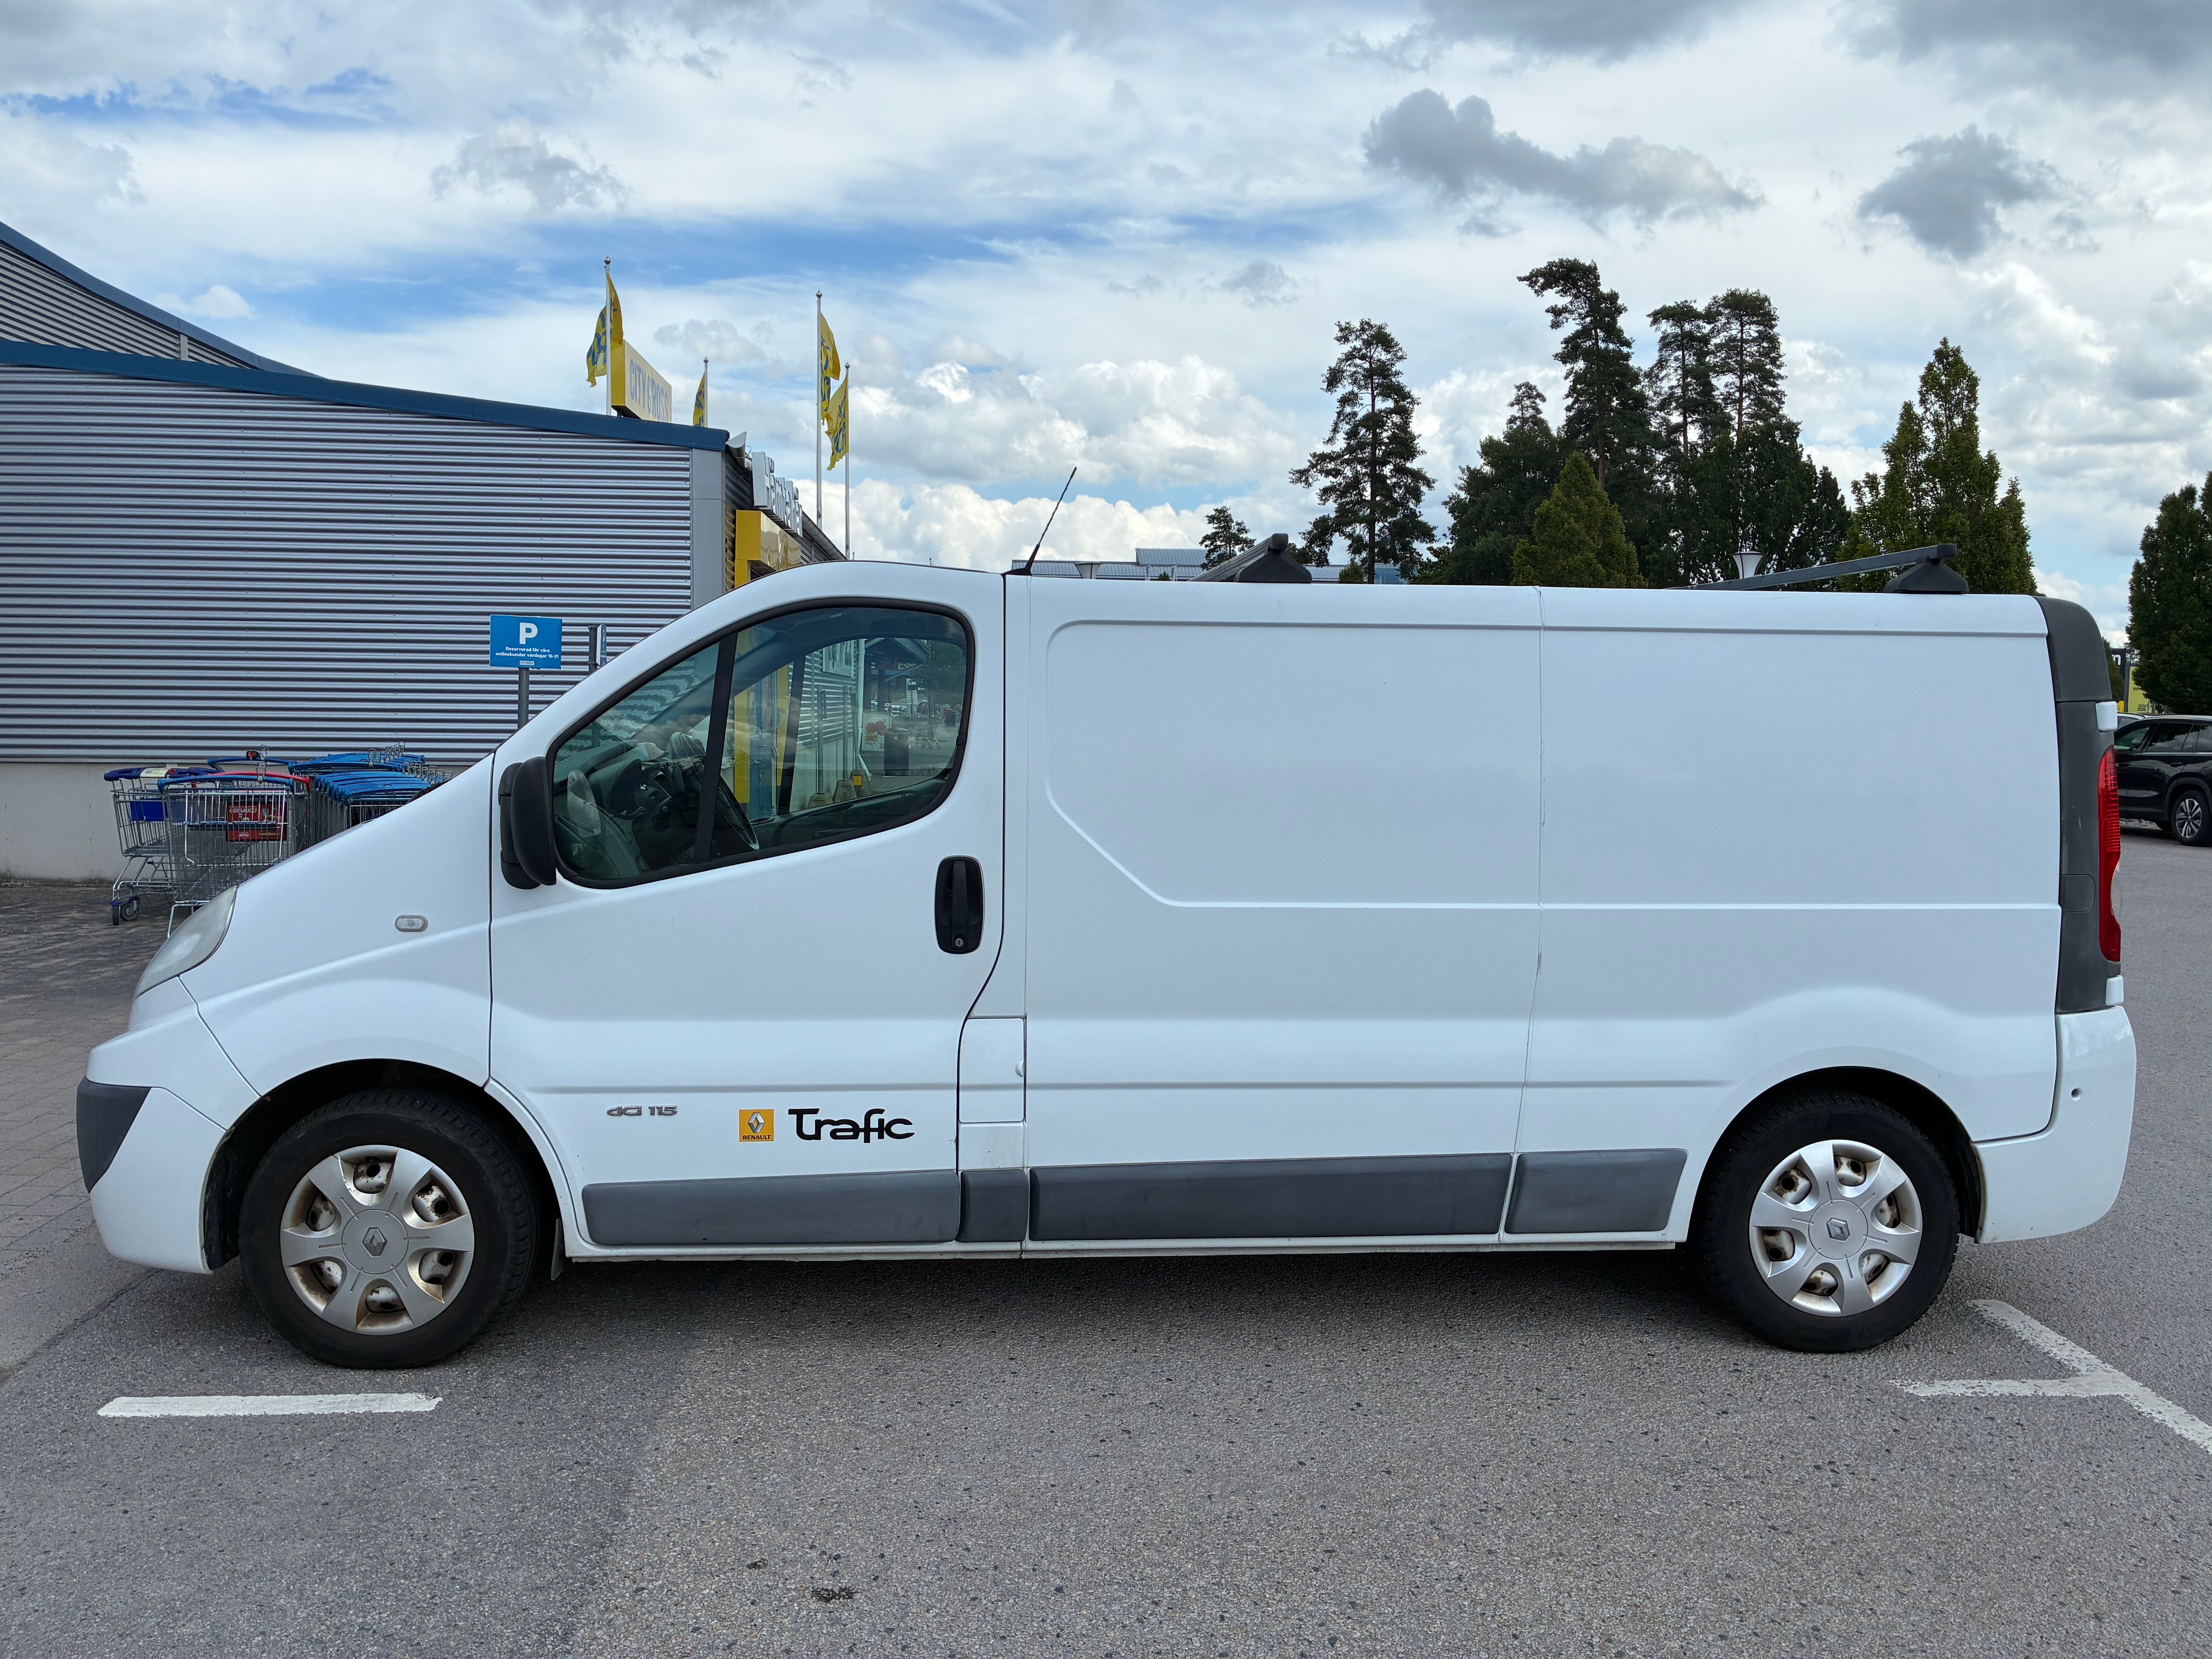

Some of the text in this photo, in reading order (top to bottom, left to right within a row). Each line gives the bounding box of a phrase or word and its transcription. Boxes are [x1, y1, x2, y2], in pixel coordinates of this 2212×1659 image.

[630, 359, 646, 409] CITY
[647, 374, 668, 422] GROSS
[519, 622, 538, 644] P
[648, 1105, 678, 1116] 115
[788, 1108, 915, 1143] Trafic
